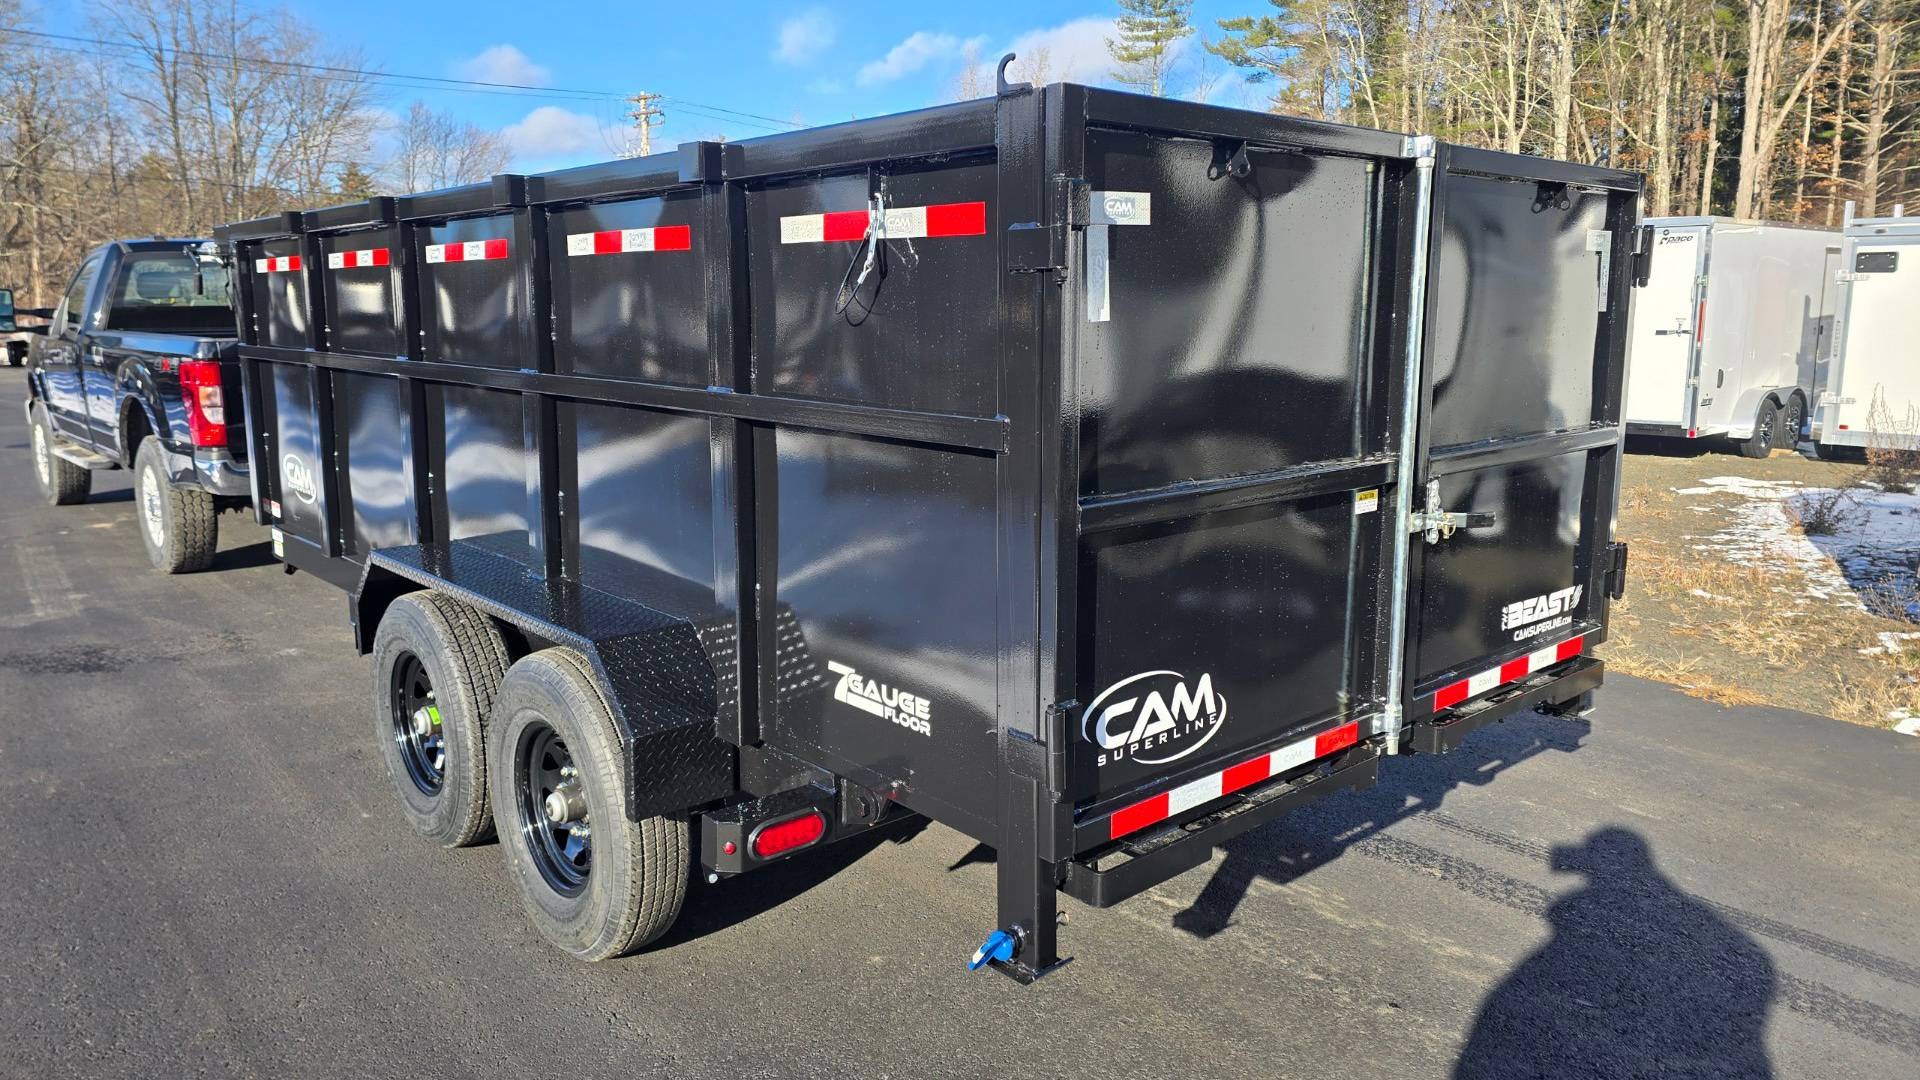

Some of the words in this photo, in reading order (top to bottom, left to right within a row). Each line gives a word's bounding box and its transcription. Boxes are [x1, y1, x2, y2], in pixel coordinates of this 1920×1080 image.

[886, 217, 911, 230] CAM
[1106, 201, 1133, 214] CAM
[287, 462, 313, 490] CAM
[1507, 586, 1576, 630] BEAST
[847, 673, 931, 720] GAUGE
[1095, 672, 1217, 750] CAM
[884, 705, 931, 737] FLOOR
[1097, 713, 1217, 767] SUPERLINE
